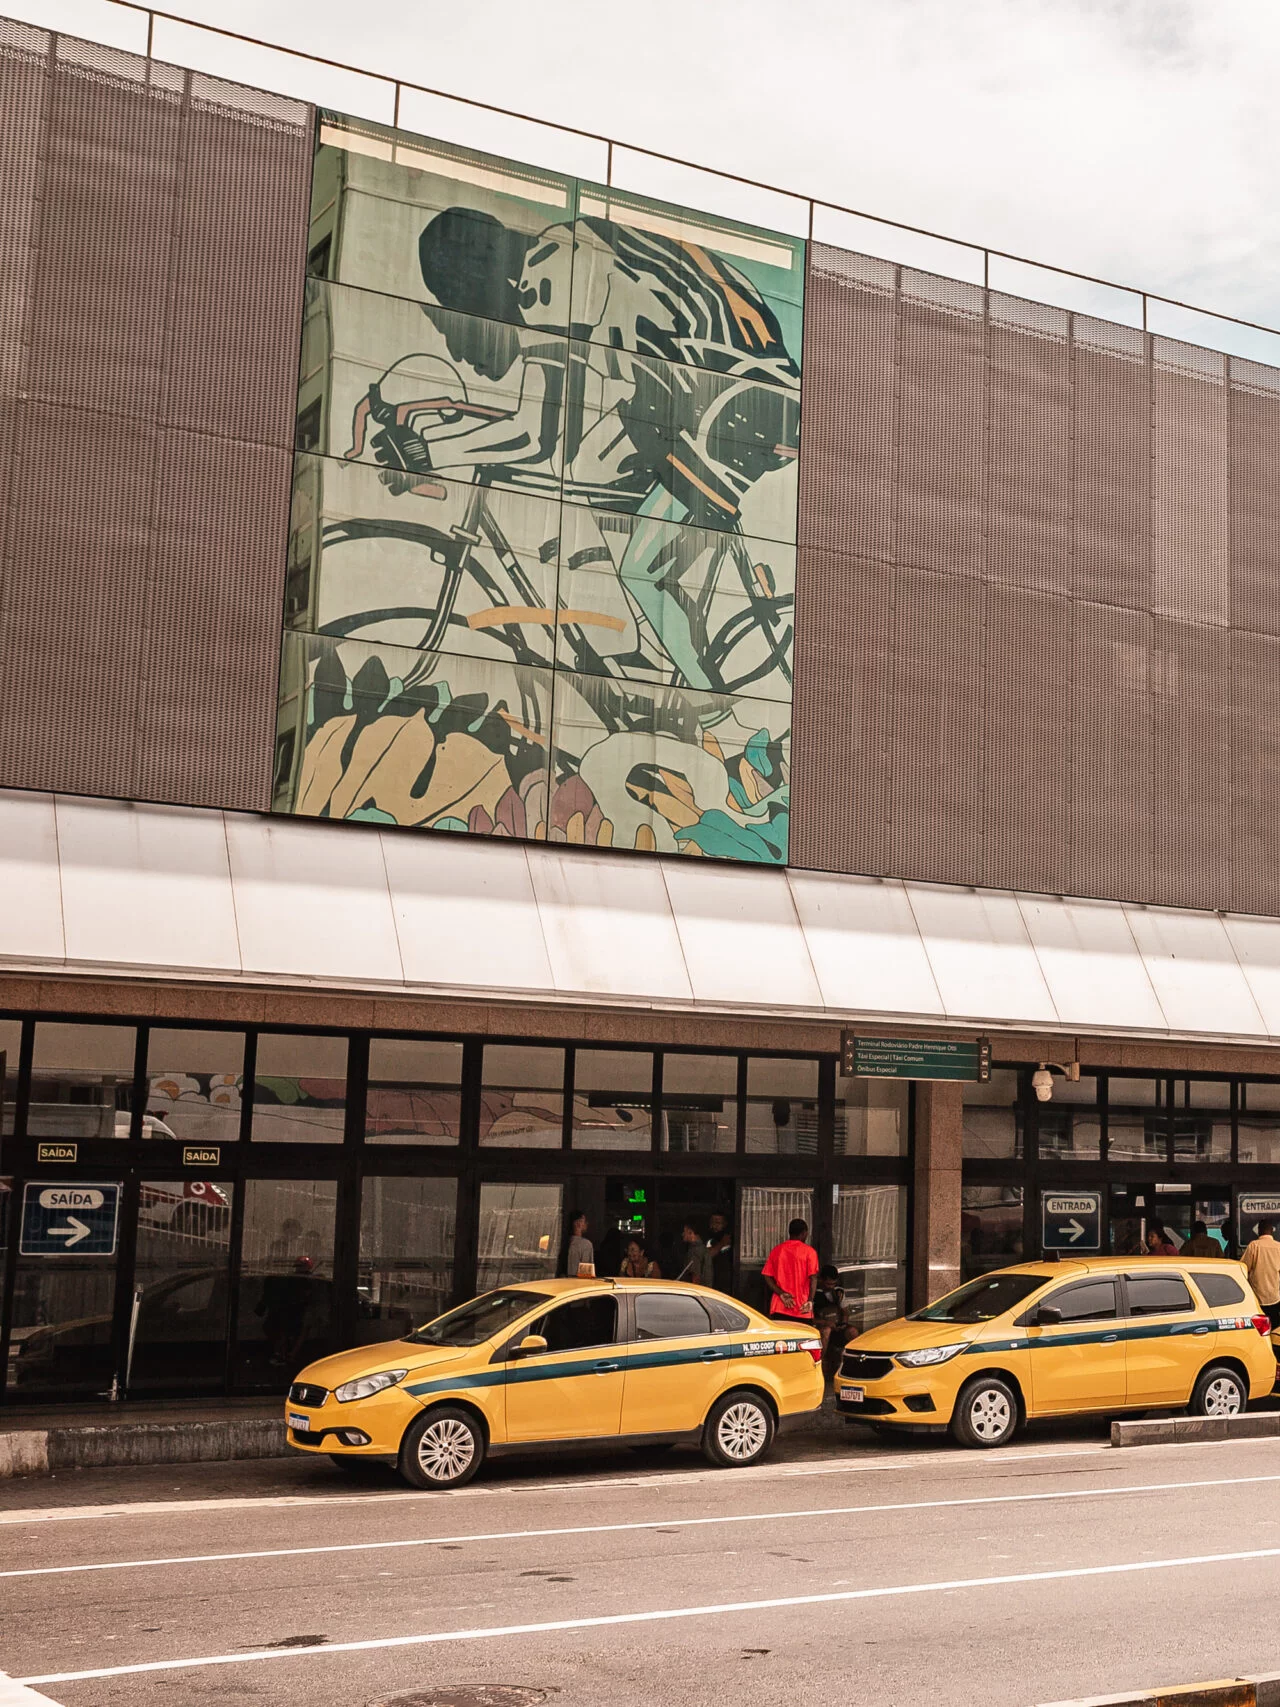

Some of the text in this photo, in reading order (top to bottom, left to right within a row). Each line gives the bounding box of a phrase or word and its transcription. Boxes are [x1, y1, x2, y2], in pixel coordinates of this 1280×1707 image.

[869, 1053, 889, 1061] Especial
[41, 1146, 74, 1158] SAÍDA
[186, 1149, 217, 1161] SAÍDA
[50, 1191, 93, 1206] SAÍDA
[1051, 1201, 1092, 1211] ENTRADA
